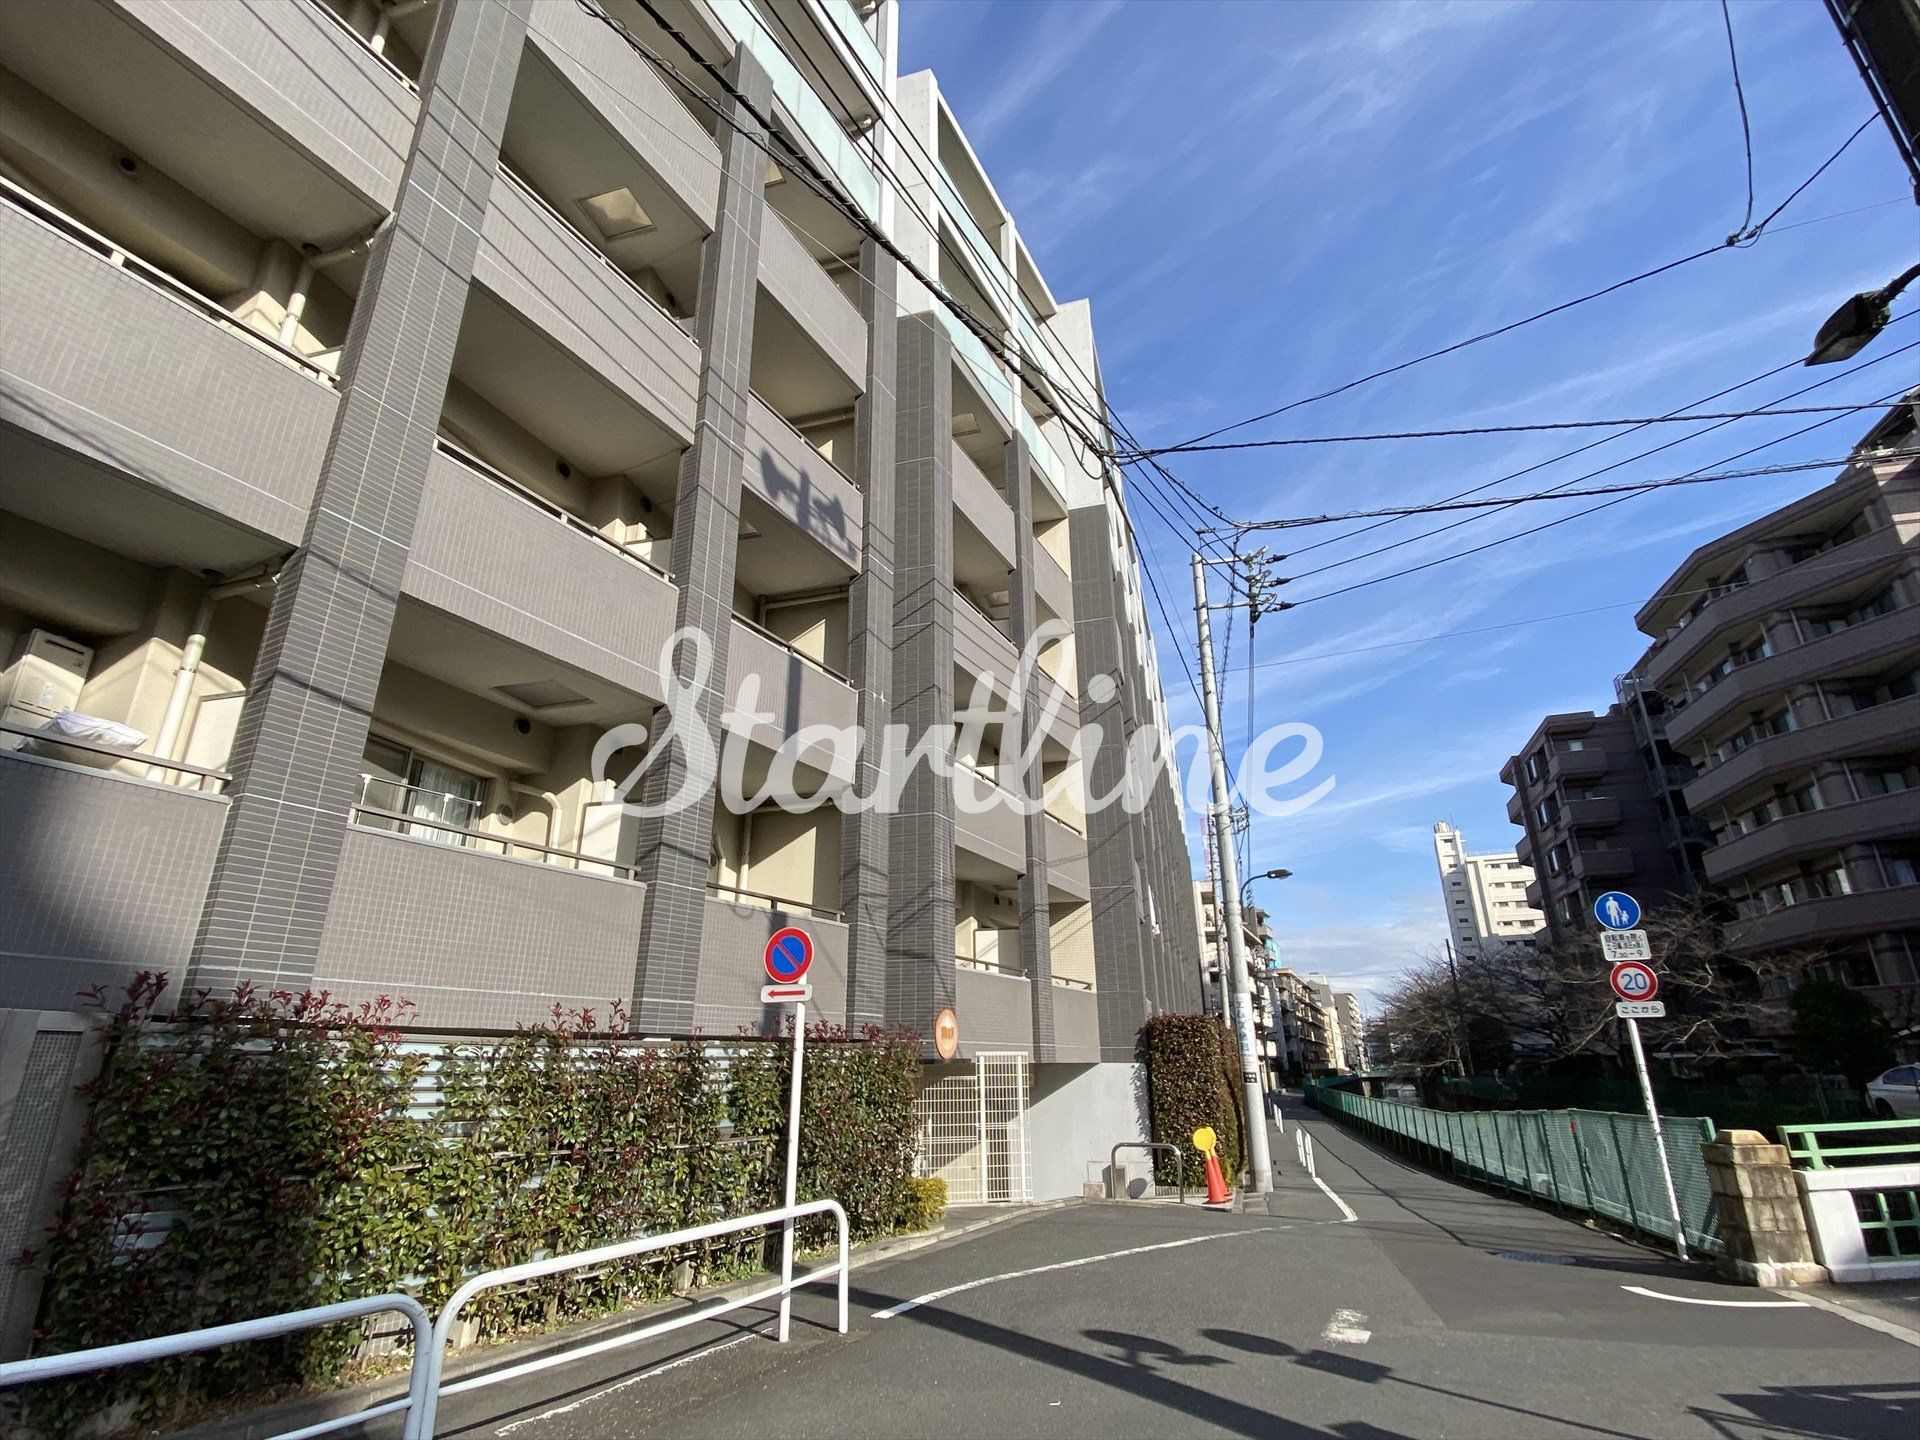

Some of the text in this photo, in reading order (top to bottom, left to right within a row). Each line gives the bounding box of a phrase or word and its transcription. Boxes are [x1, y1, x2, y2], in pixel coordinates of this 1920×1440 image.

[1621, 973, 1647, 990] 20
[1621, 1005, 1660, 1014] ここから
